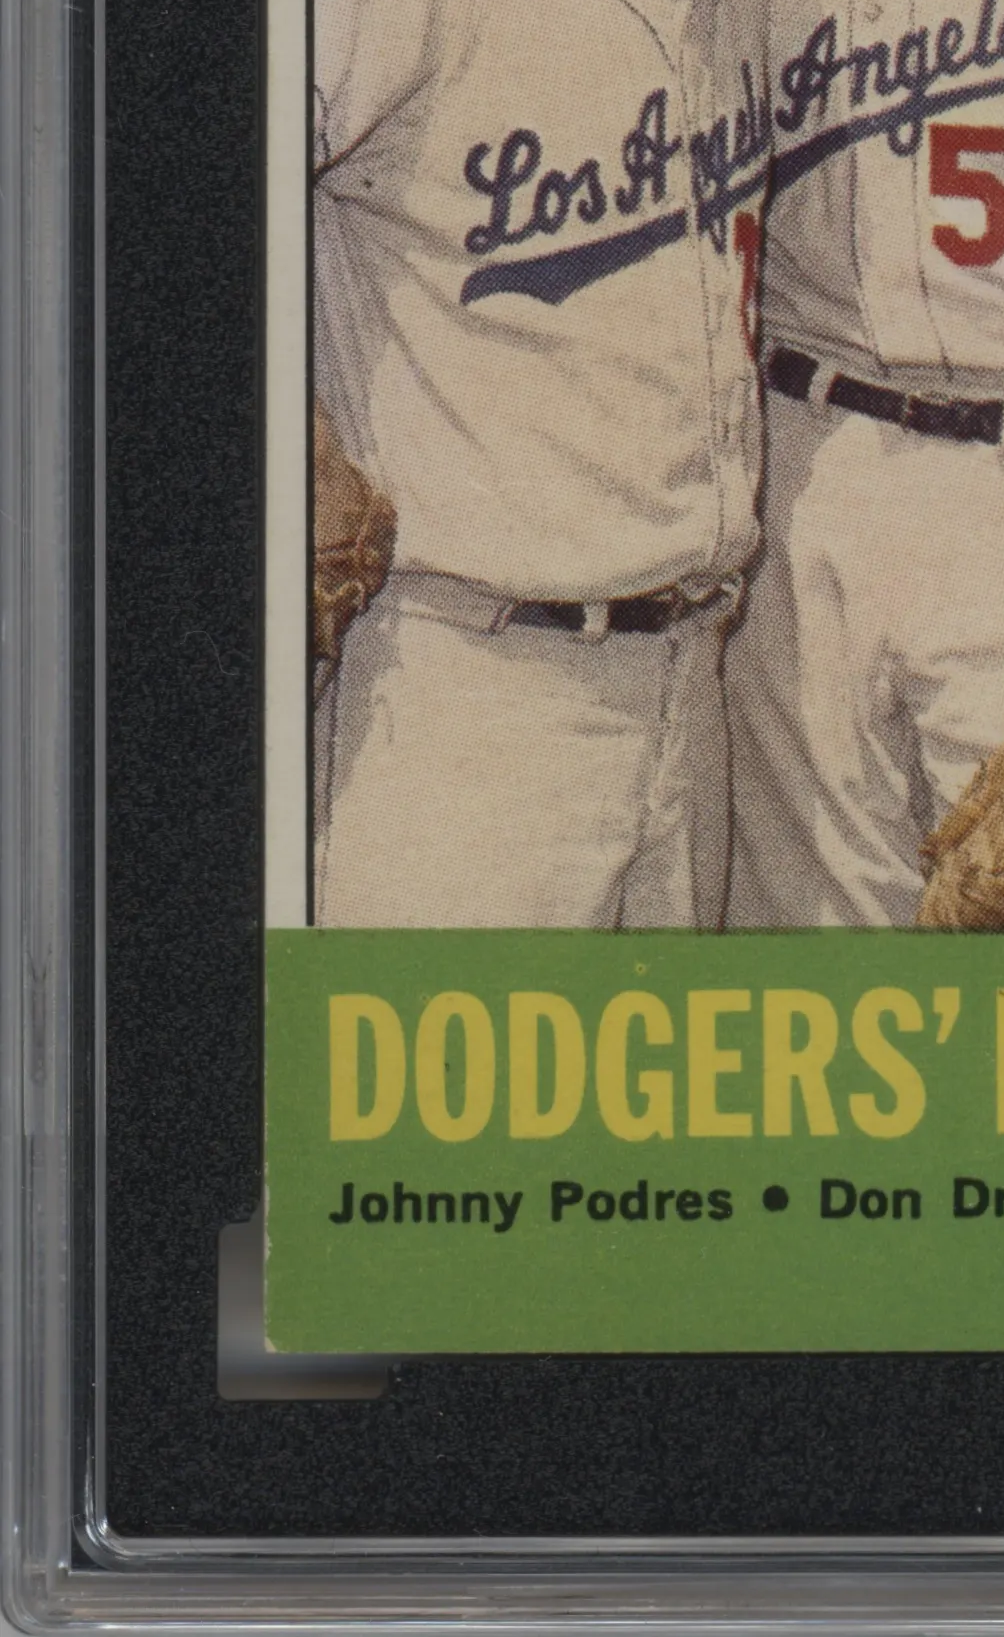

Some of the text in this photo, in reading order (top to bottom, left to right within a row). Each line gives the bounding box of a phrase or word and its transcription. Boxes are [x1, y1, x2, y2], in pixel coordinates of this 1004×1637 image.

[464, 129, 605, 254] Los
[329, 1182, 523, 1232] Johnny
[551, 1180, 733, 1222] Podres
[820, 1178, 922, 1219] Don
